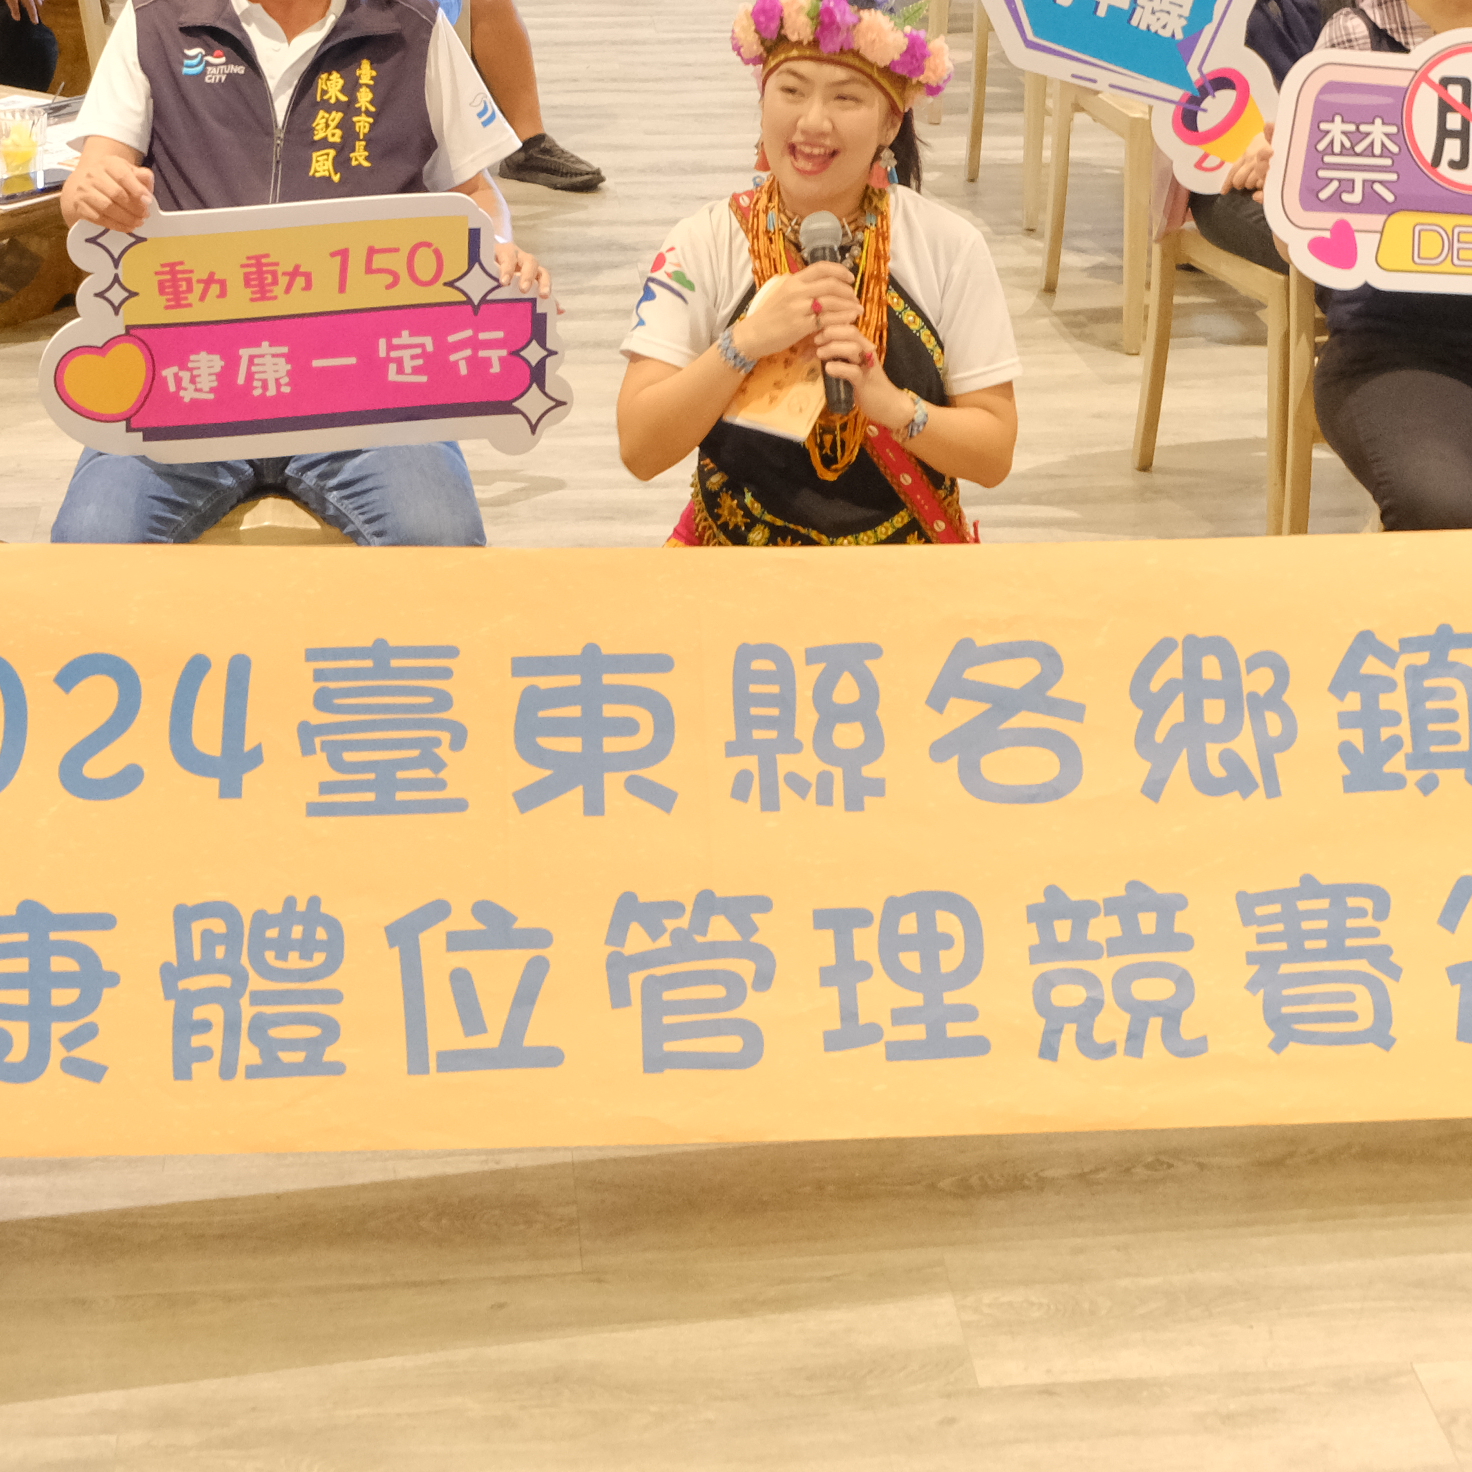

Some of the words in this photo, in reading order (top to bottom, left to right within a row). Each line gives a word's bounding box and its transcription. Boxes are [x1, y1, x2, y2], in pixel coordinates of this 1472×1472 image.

[204, 73, 227, 84] CITY
[205, 64, 246, 75] TAITUNG
[308, 70, 349, 183] 陳銘風
[349, 58, 378, 167] 臺東市長
[153, 239, 446, 312] 動動150
[162, 327, 510, 404] 健康一定行
